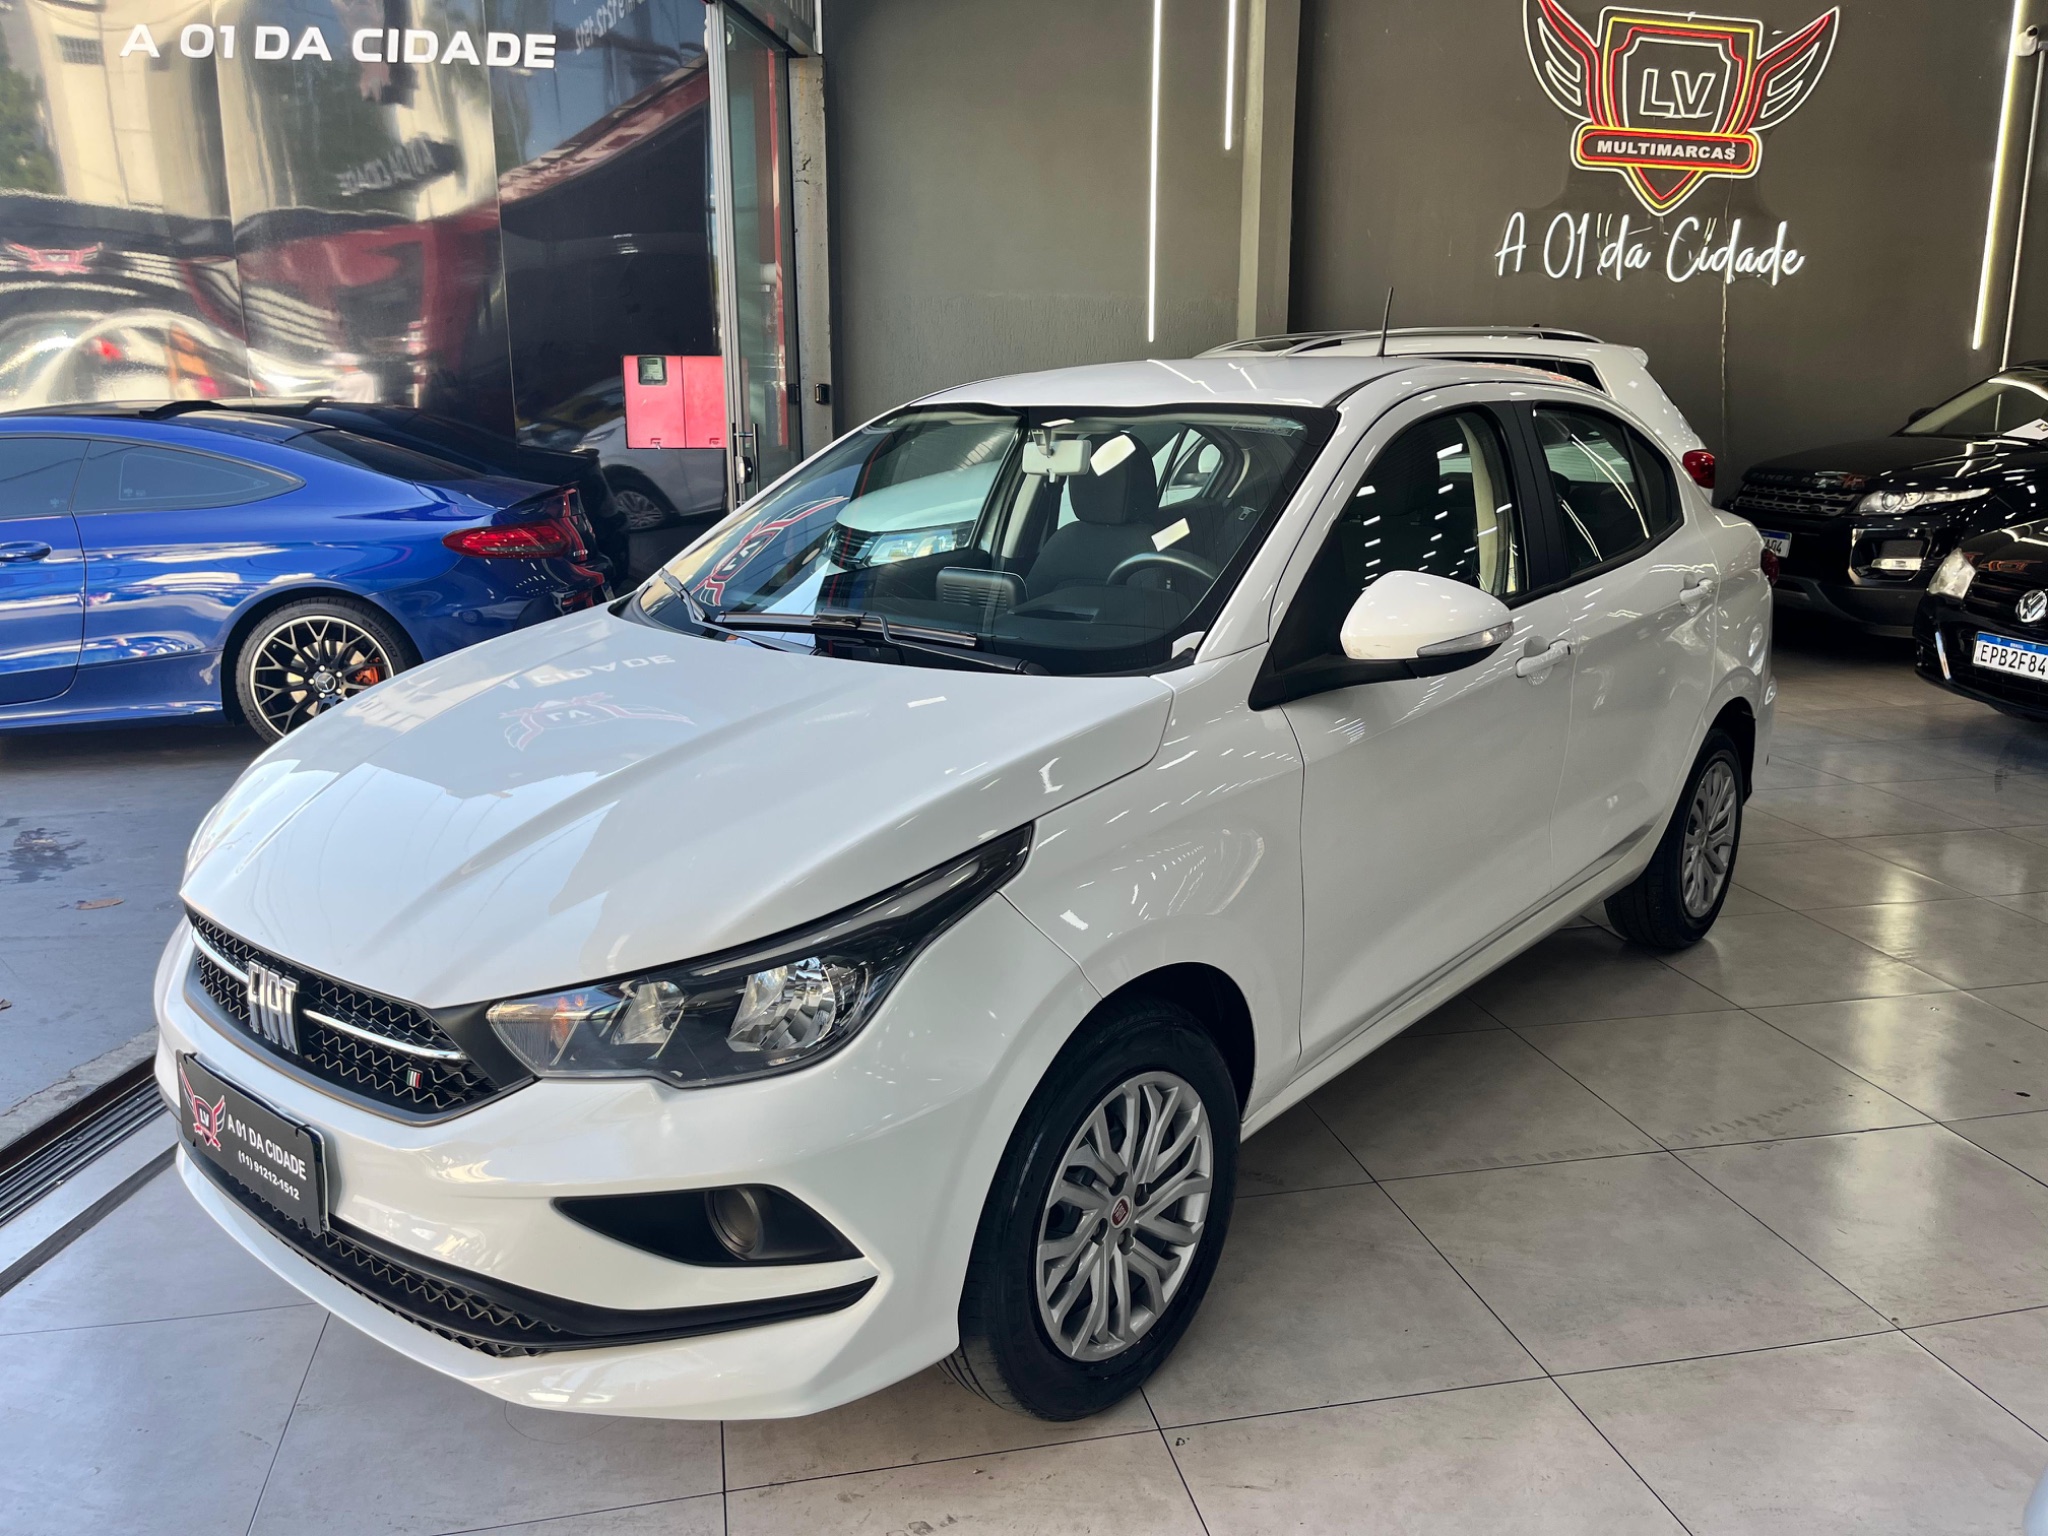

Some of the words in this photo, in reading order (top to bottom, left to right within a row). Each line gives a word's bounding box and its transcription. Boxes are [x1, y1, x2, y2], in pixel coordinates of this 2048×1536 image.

[119, 23, 160, 58] A
[180, 23, 235, 59] 01
[254, 25, 333, 61] DA
[352, 28, 557, 68] CIDADE
[1639, 67, 1716, 119] LV
[1597, 140, 1736, 160] MULTIMARCAS
[1494, 211, 1527, 276] A
[1600, 214, 1651, 282] da
[1666, 216, 1806, 287] Cidade
[1980, 644, 2047, 676] EPB2F84
[247, 958, 299, 1055] FIAT
[199, 1108, 209, 1127] LV
[228, 1114, 235, 1133] A
[235, 1119, 247, 1141] 01
[248, 1127, 265, 1153] DA
[265, 1139, 307, 1181] CIDADE
[238, 1150, 253, 1171] (11)
[254, 1163, 300, 1201] 91212-1512
